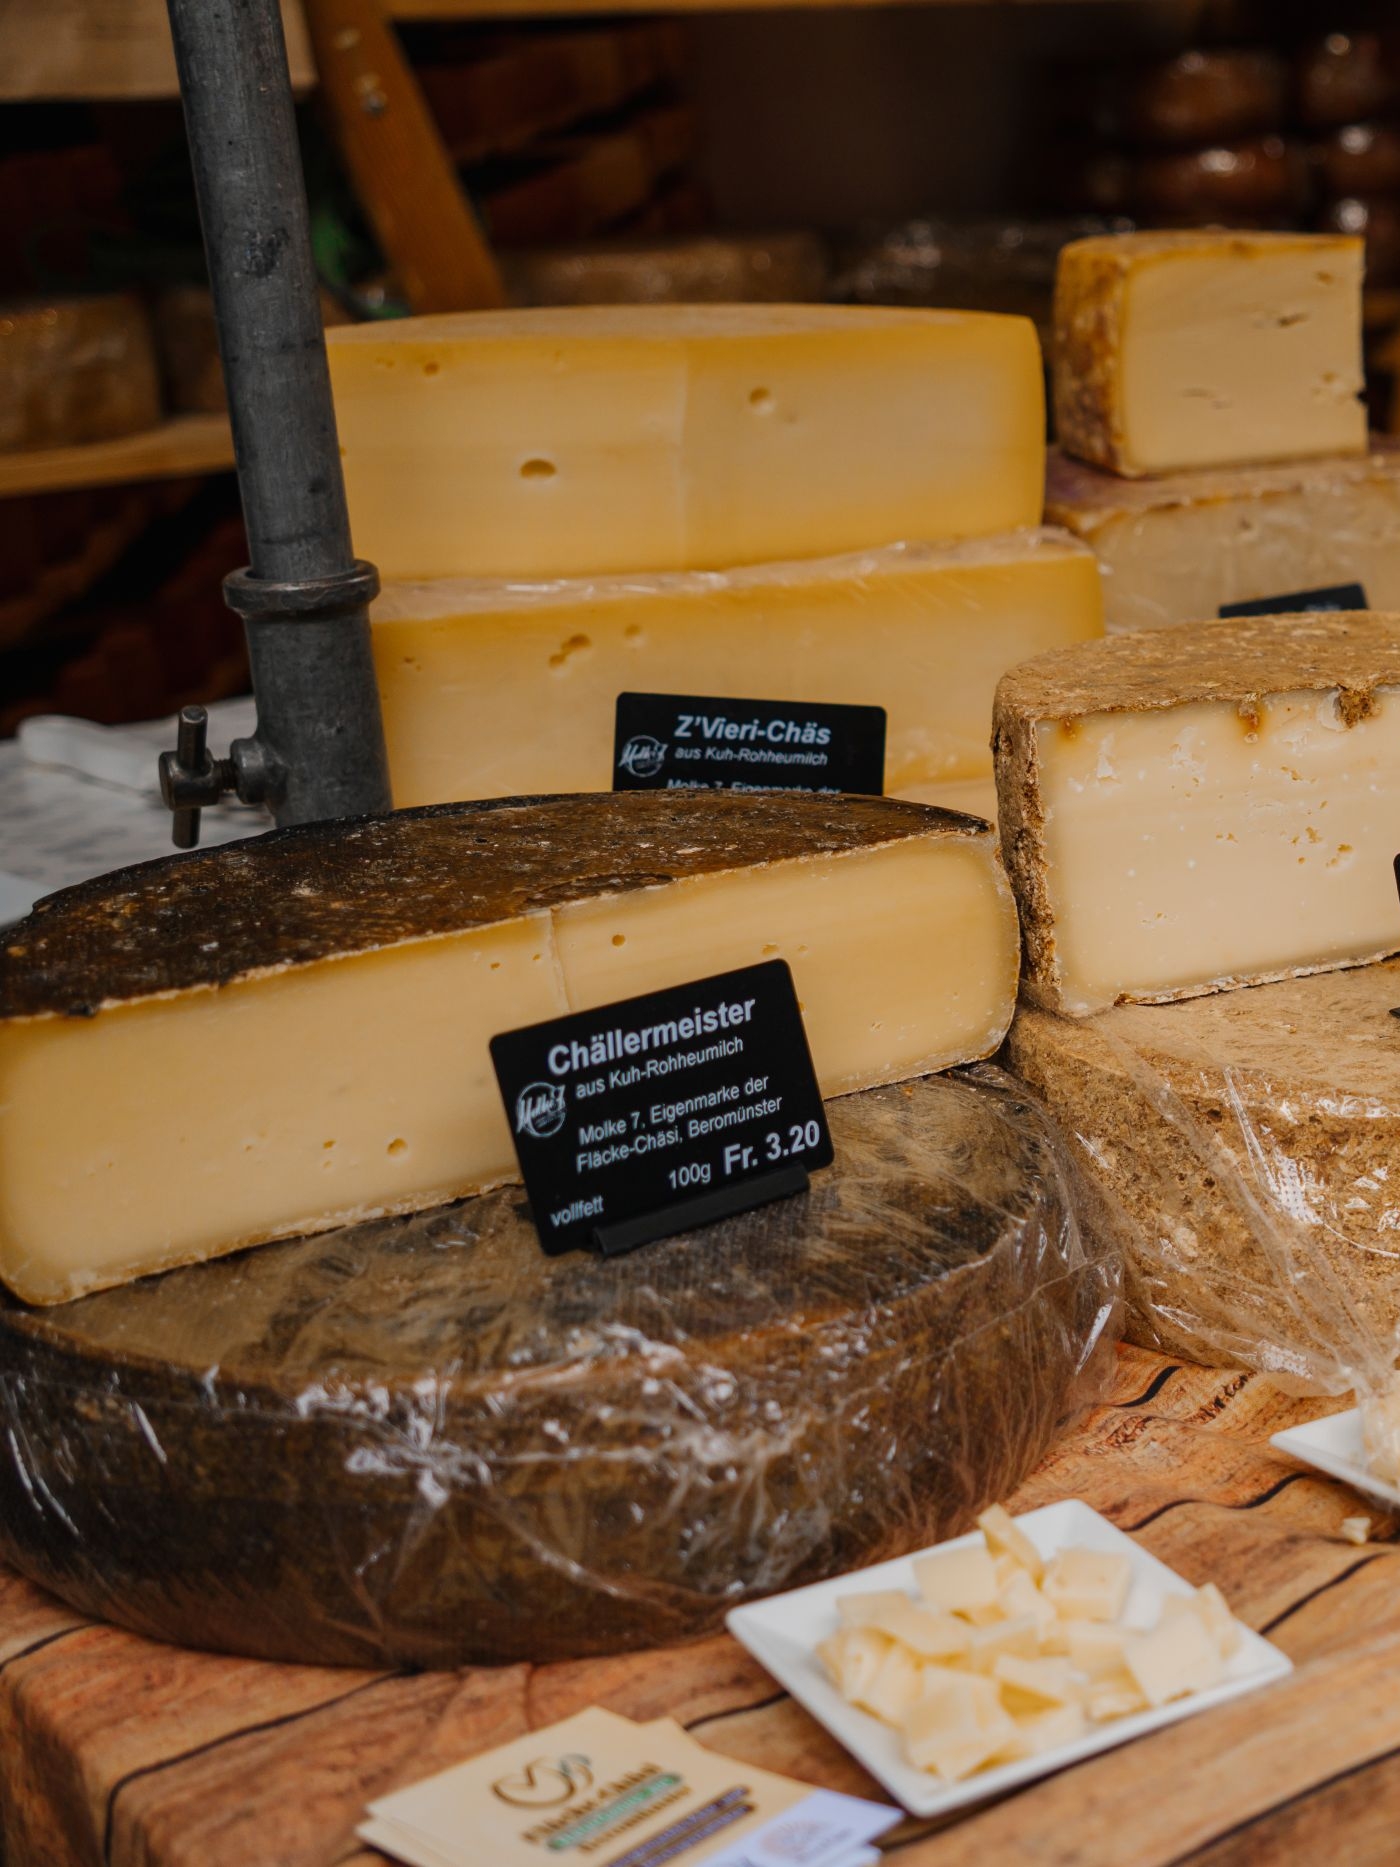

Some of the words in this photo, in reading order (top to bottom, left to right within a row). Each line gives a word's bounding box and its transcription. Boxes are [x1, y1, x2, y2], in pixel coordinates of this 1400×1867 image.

[674, 715, 832, 745] Z'Vieri-Chäs
[674, 747, 702, 760] aus
[704, 747, 829, 766] Kuh-Rohheumilch
[548, 997, 756, 1075] Chällermeister
[576, 1079, 606, 1099] aus
[609, 1037, 744, 1090] Kuh-Rohheumilch
[576, 1127, 683, 1174] Fläcke-Chäsi,
[688, 1097, 783, 1138] Beromünster
[578, 1117, 627, 1146] Molke
[650, 1085, 740, 1125] Eigenmarke
[744, 1075, 770, 1095] der
[551, 1196, 605, 1228] vollfett
[668, 1161, 712, 1190] 100g
[723, 1143, 759, 1175] Fr.
[766, 1119, 820, 1161] 3.20
